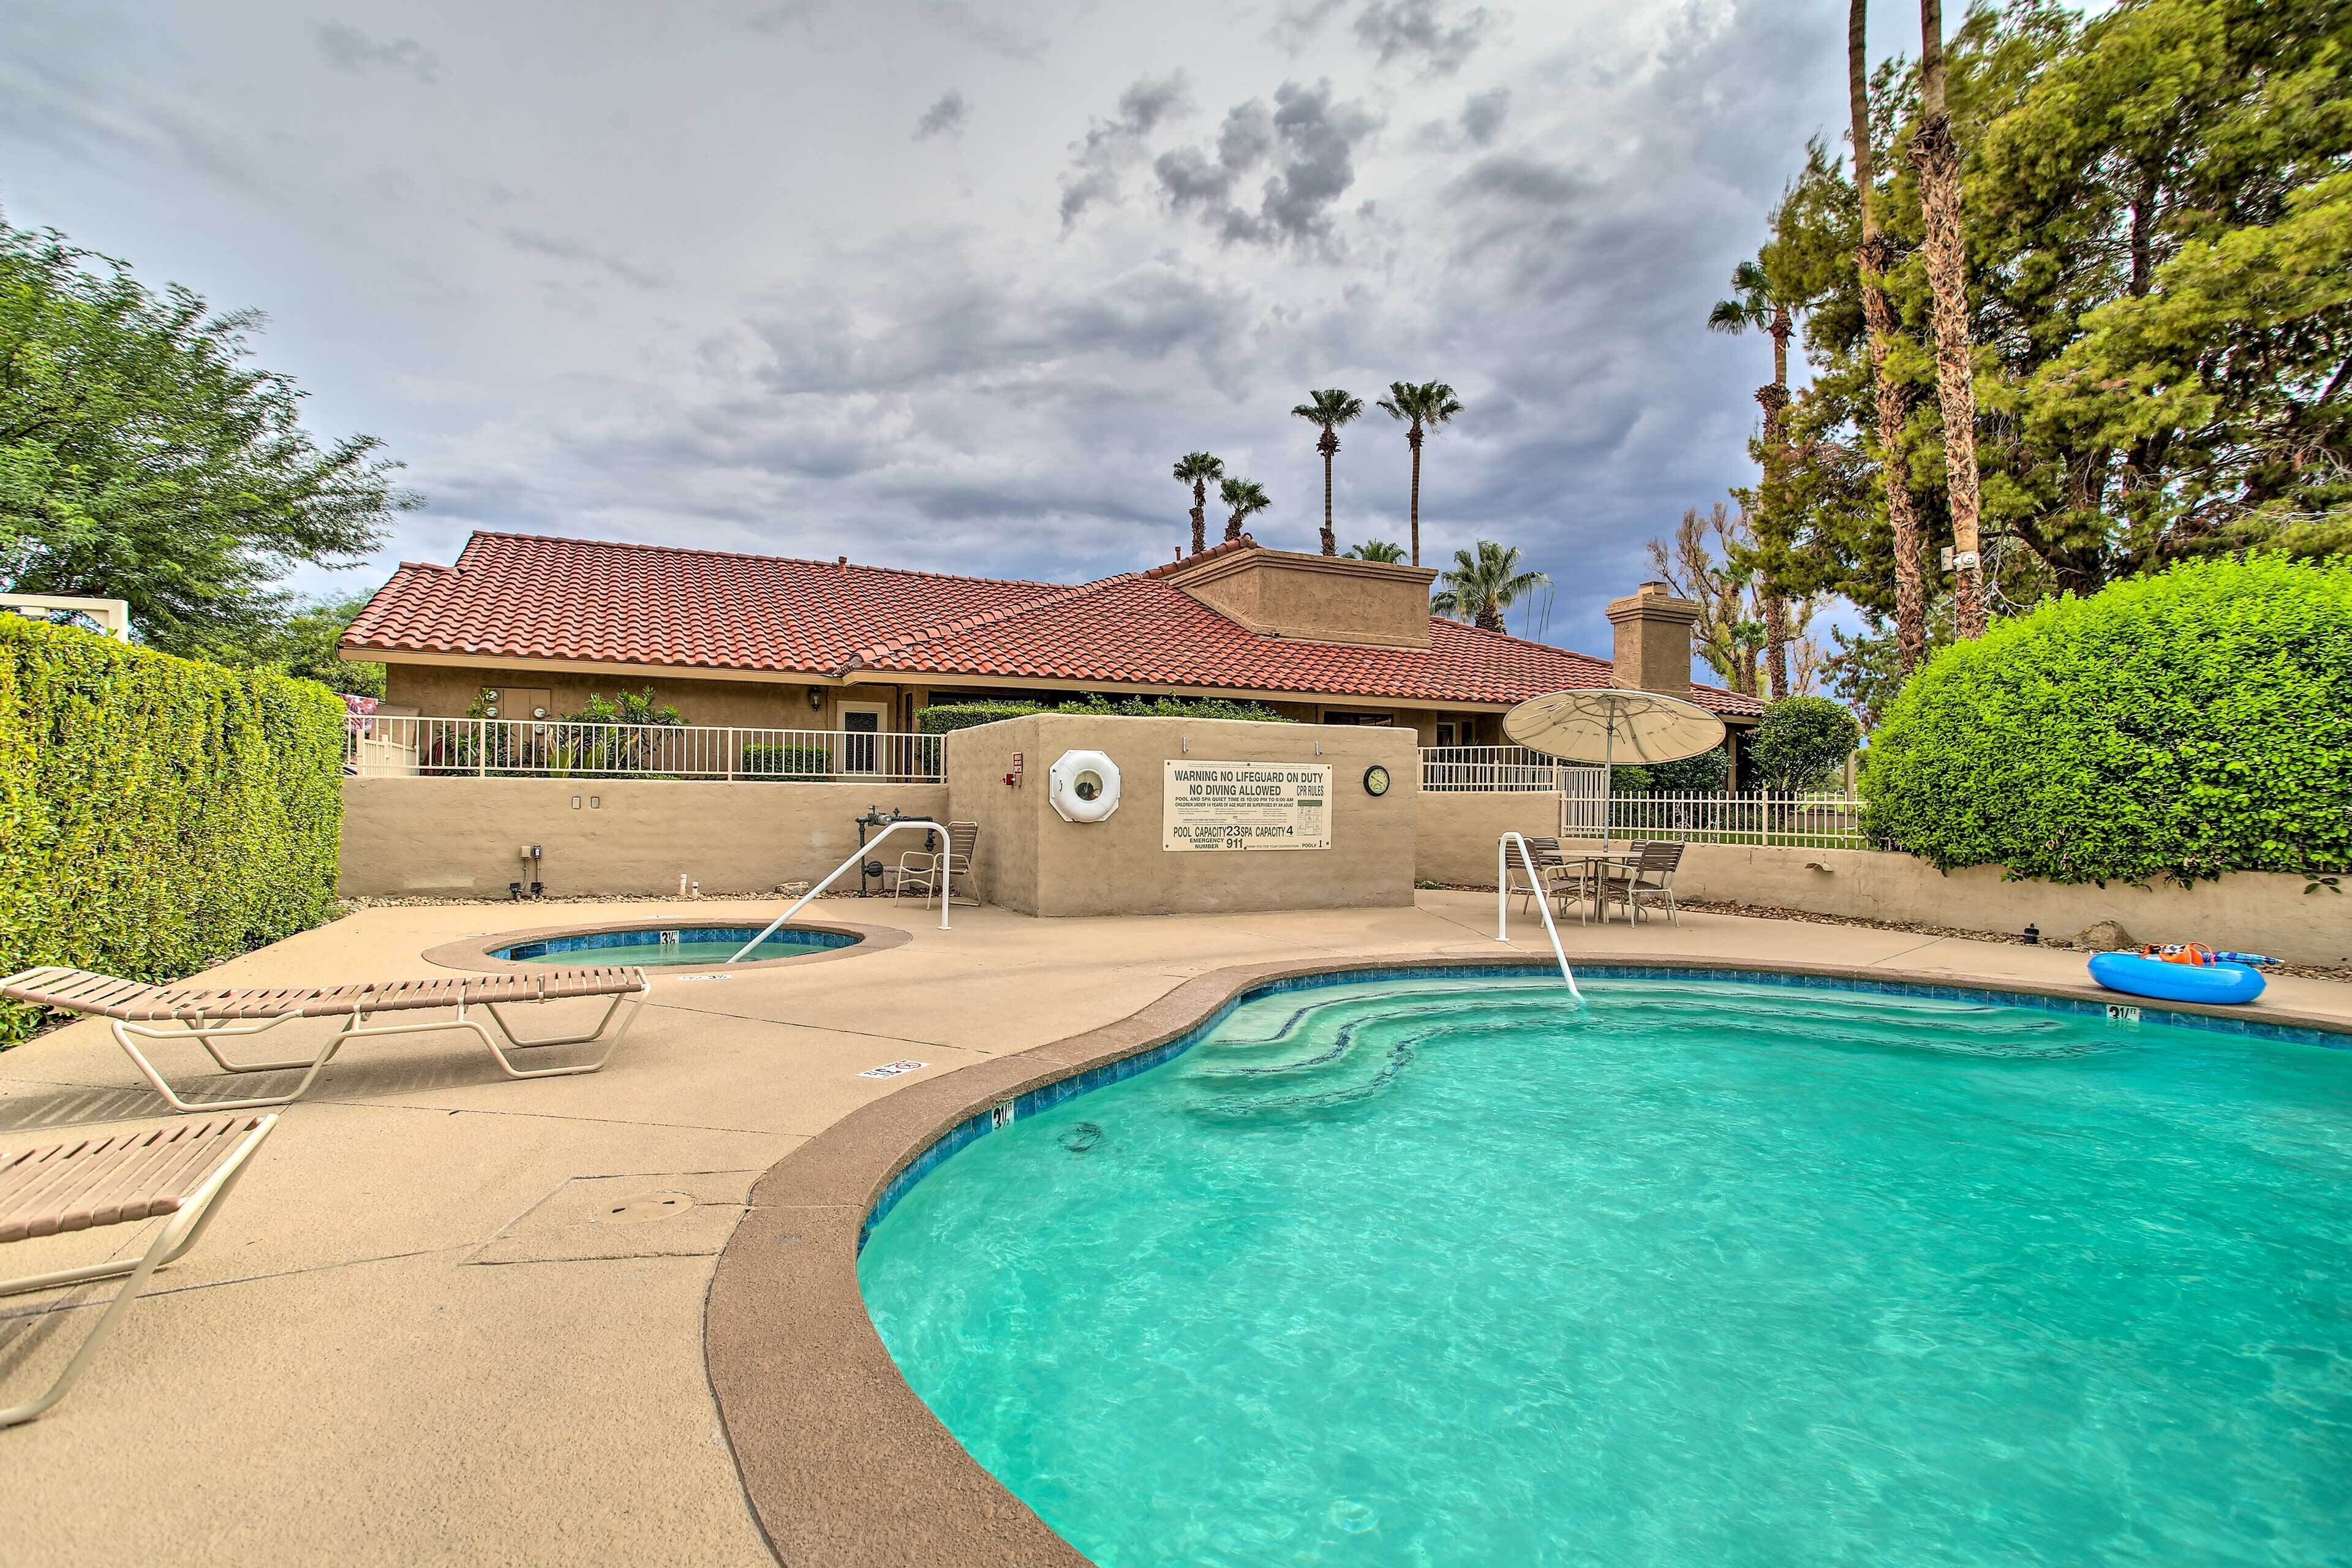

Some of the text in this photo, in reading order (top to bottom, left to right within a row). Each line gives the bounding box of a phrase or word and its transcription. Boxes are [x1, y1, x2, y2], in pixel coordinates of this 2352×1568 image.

[1174, 770, 1323, 783] WARNING NO LIFEGUARD ON DUTY
[1189, 785, 1281, 796] NO DIVING ALLOWED
[1297, 785, 1324, 796] CPR RULES
[1174, 826, 1294, 837] POOL CAPACITY 23 SPA CAPACITY 4
[1226, 838, 1243, 848] 911
[1008, 1101, 1012, 1111] FT
